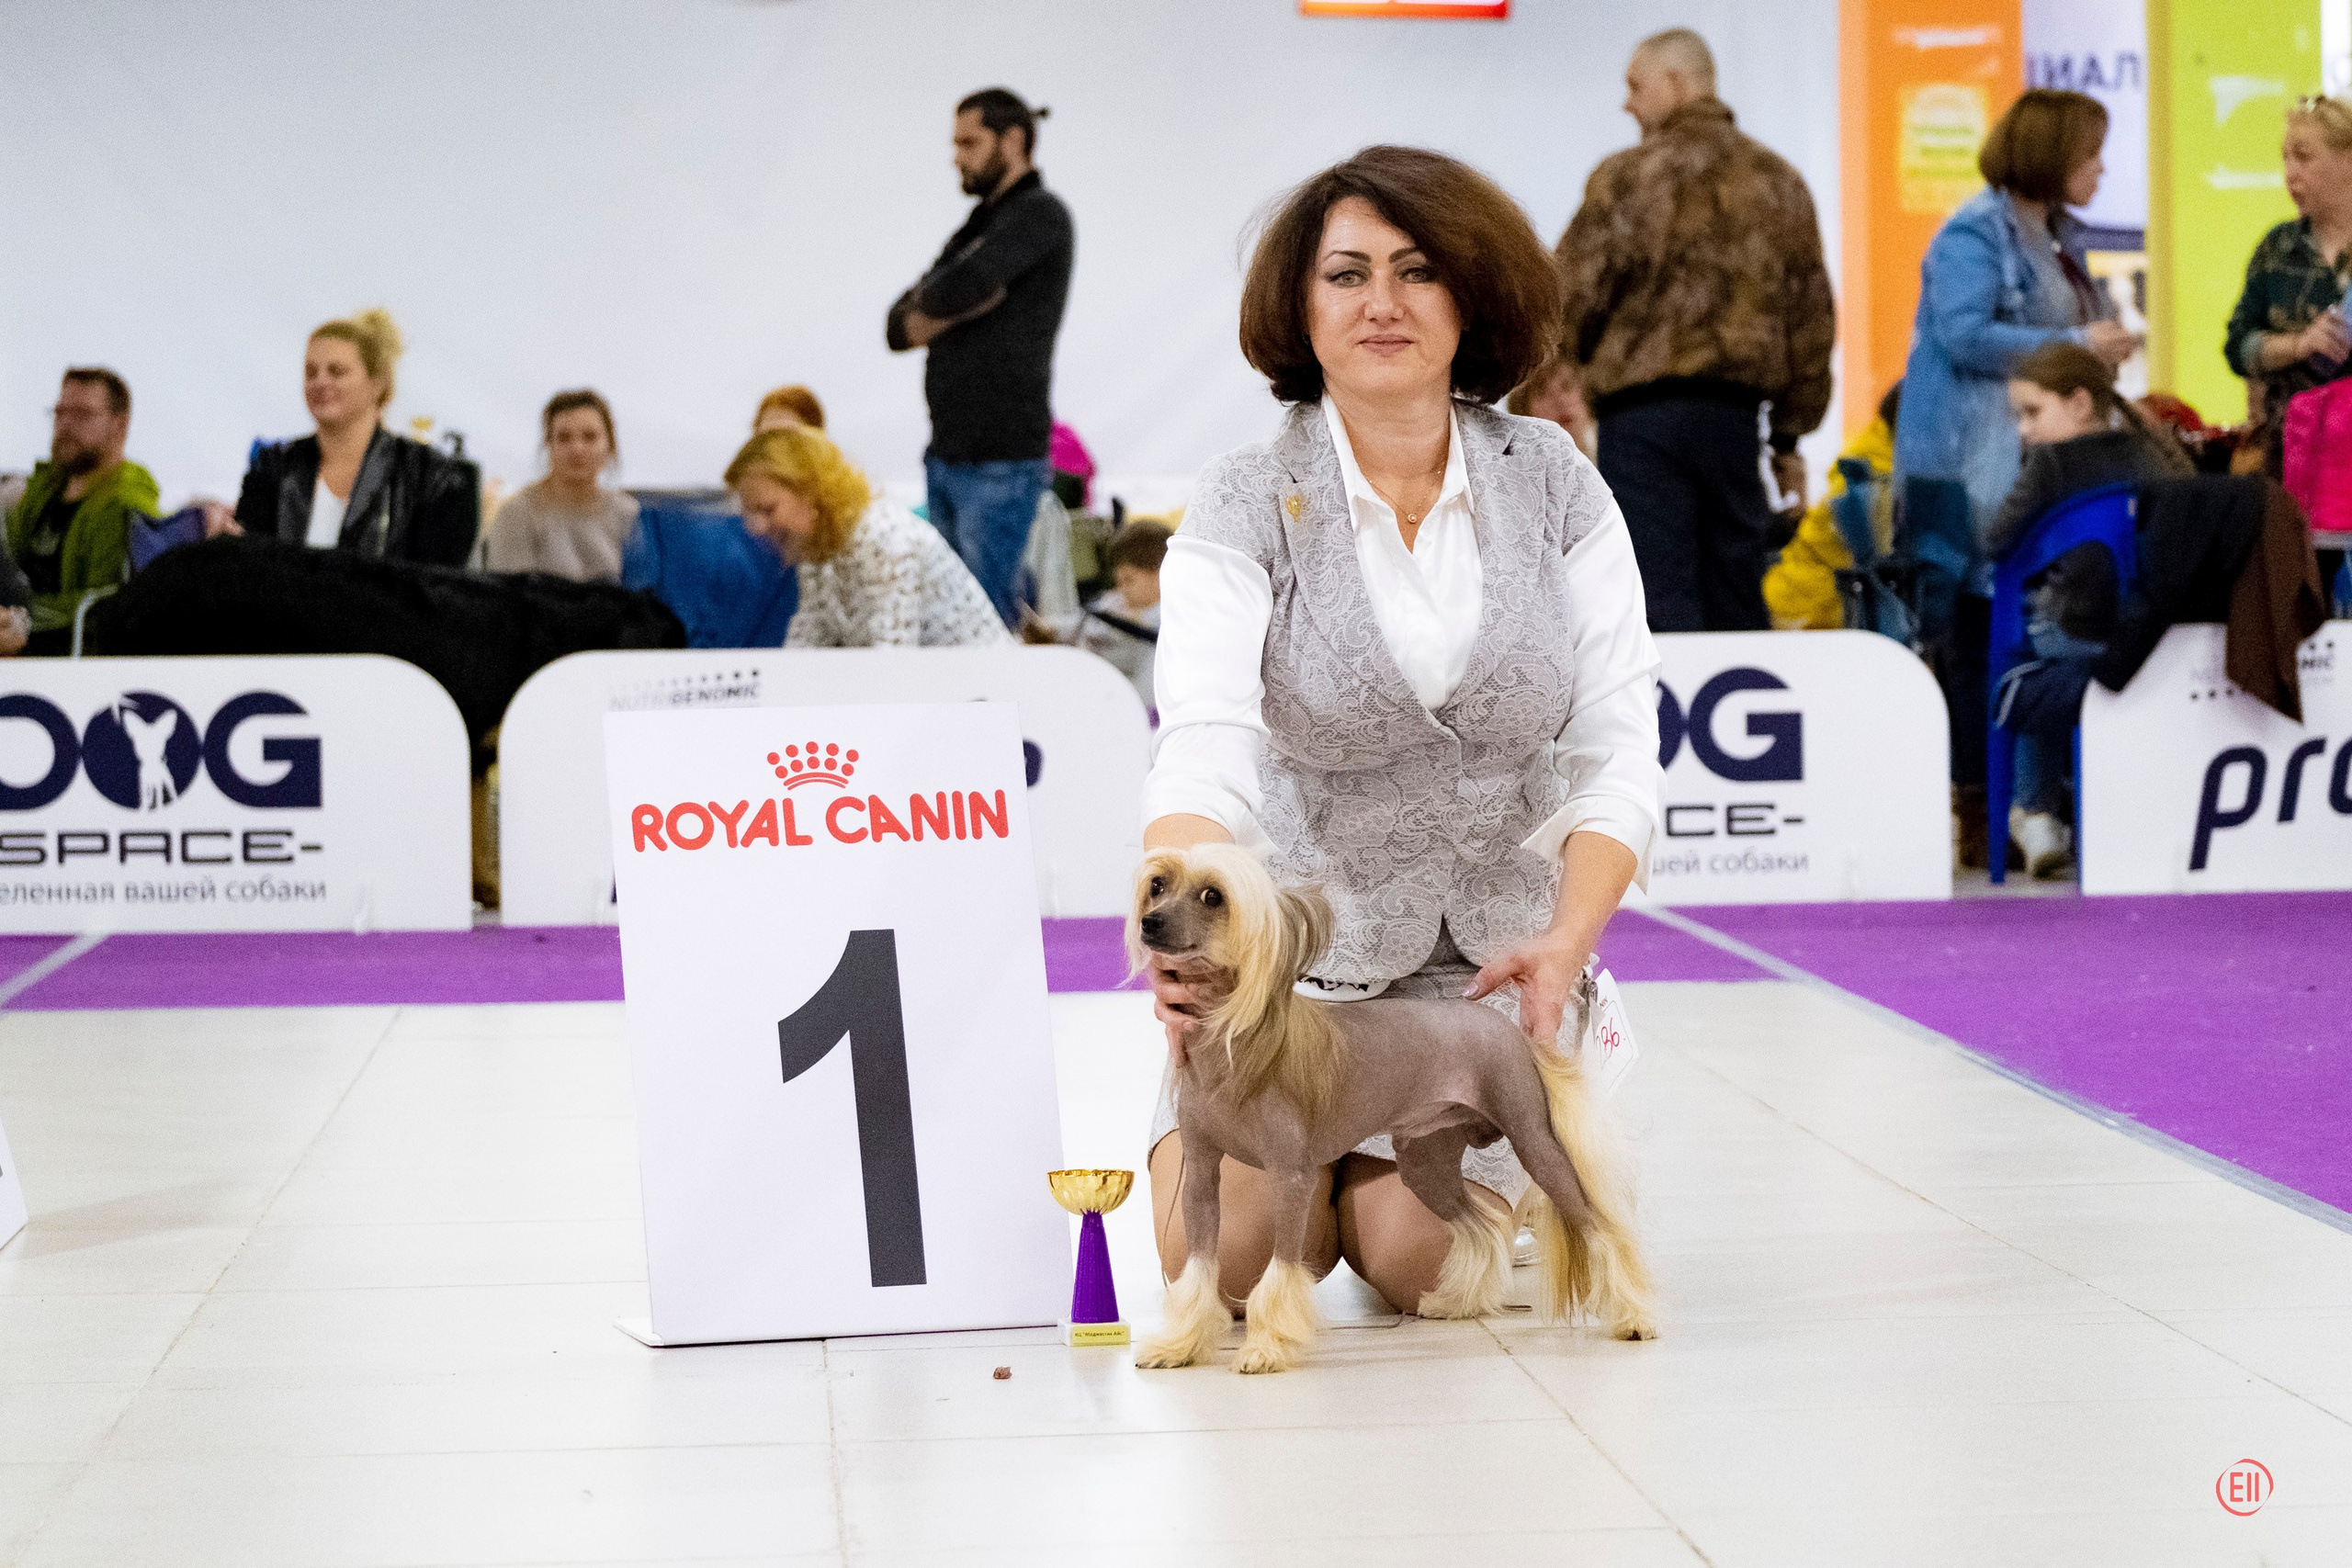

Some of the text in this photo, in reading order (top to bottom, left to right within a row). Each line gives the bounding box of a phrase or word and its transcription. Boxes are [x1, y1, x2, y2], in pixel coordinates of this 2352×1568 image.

[631, 789, 1009, 852] ROYAL CANIN
[124, 875, 216, 903] вашей
[225, 873, 326, 903] собаки
[778, 929, 927, 1288] 1
